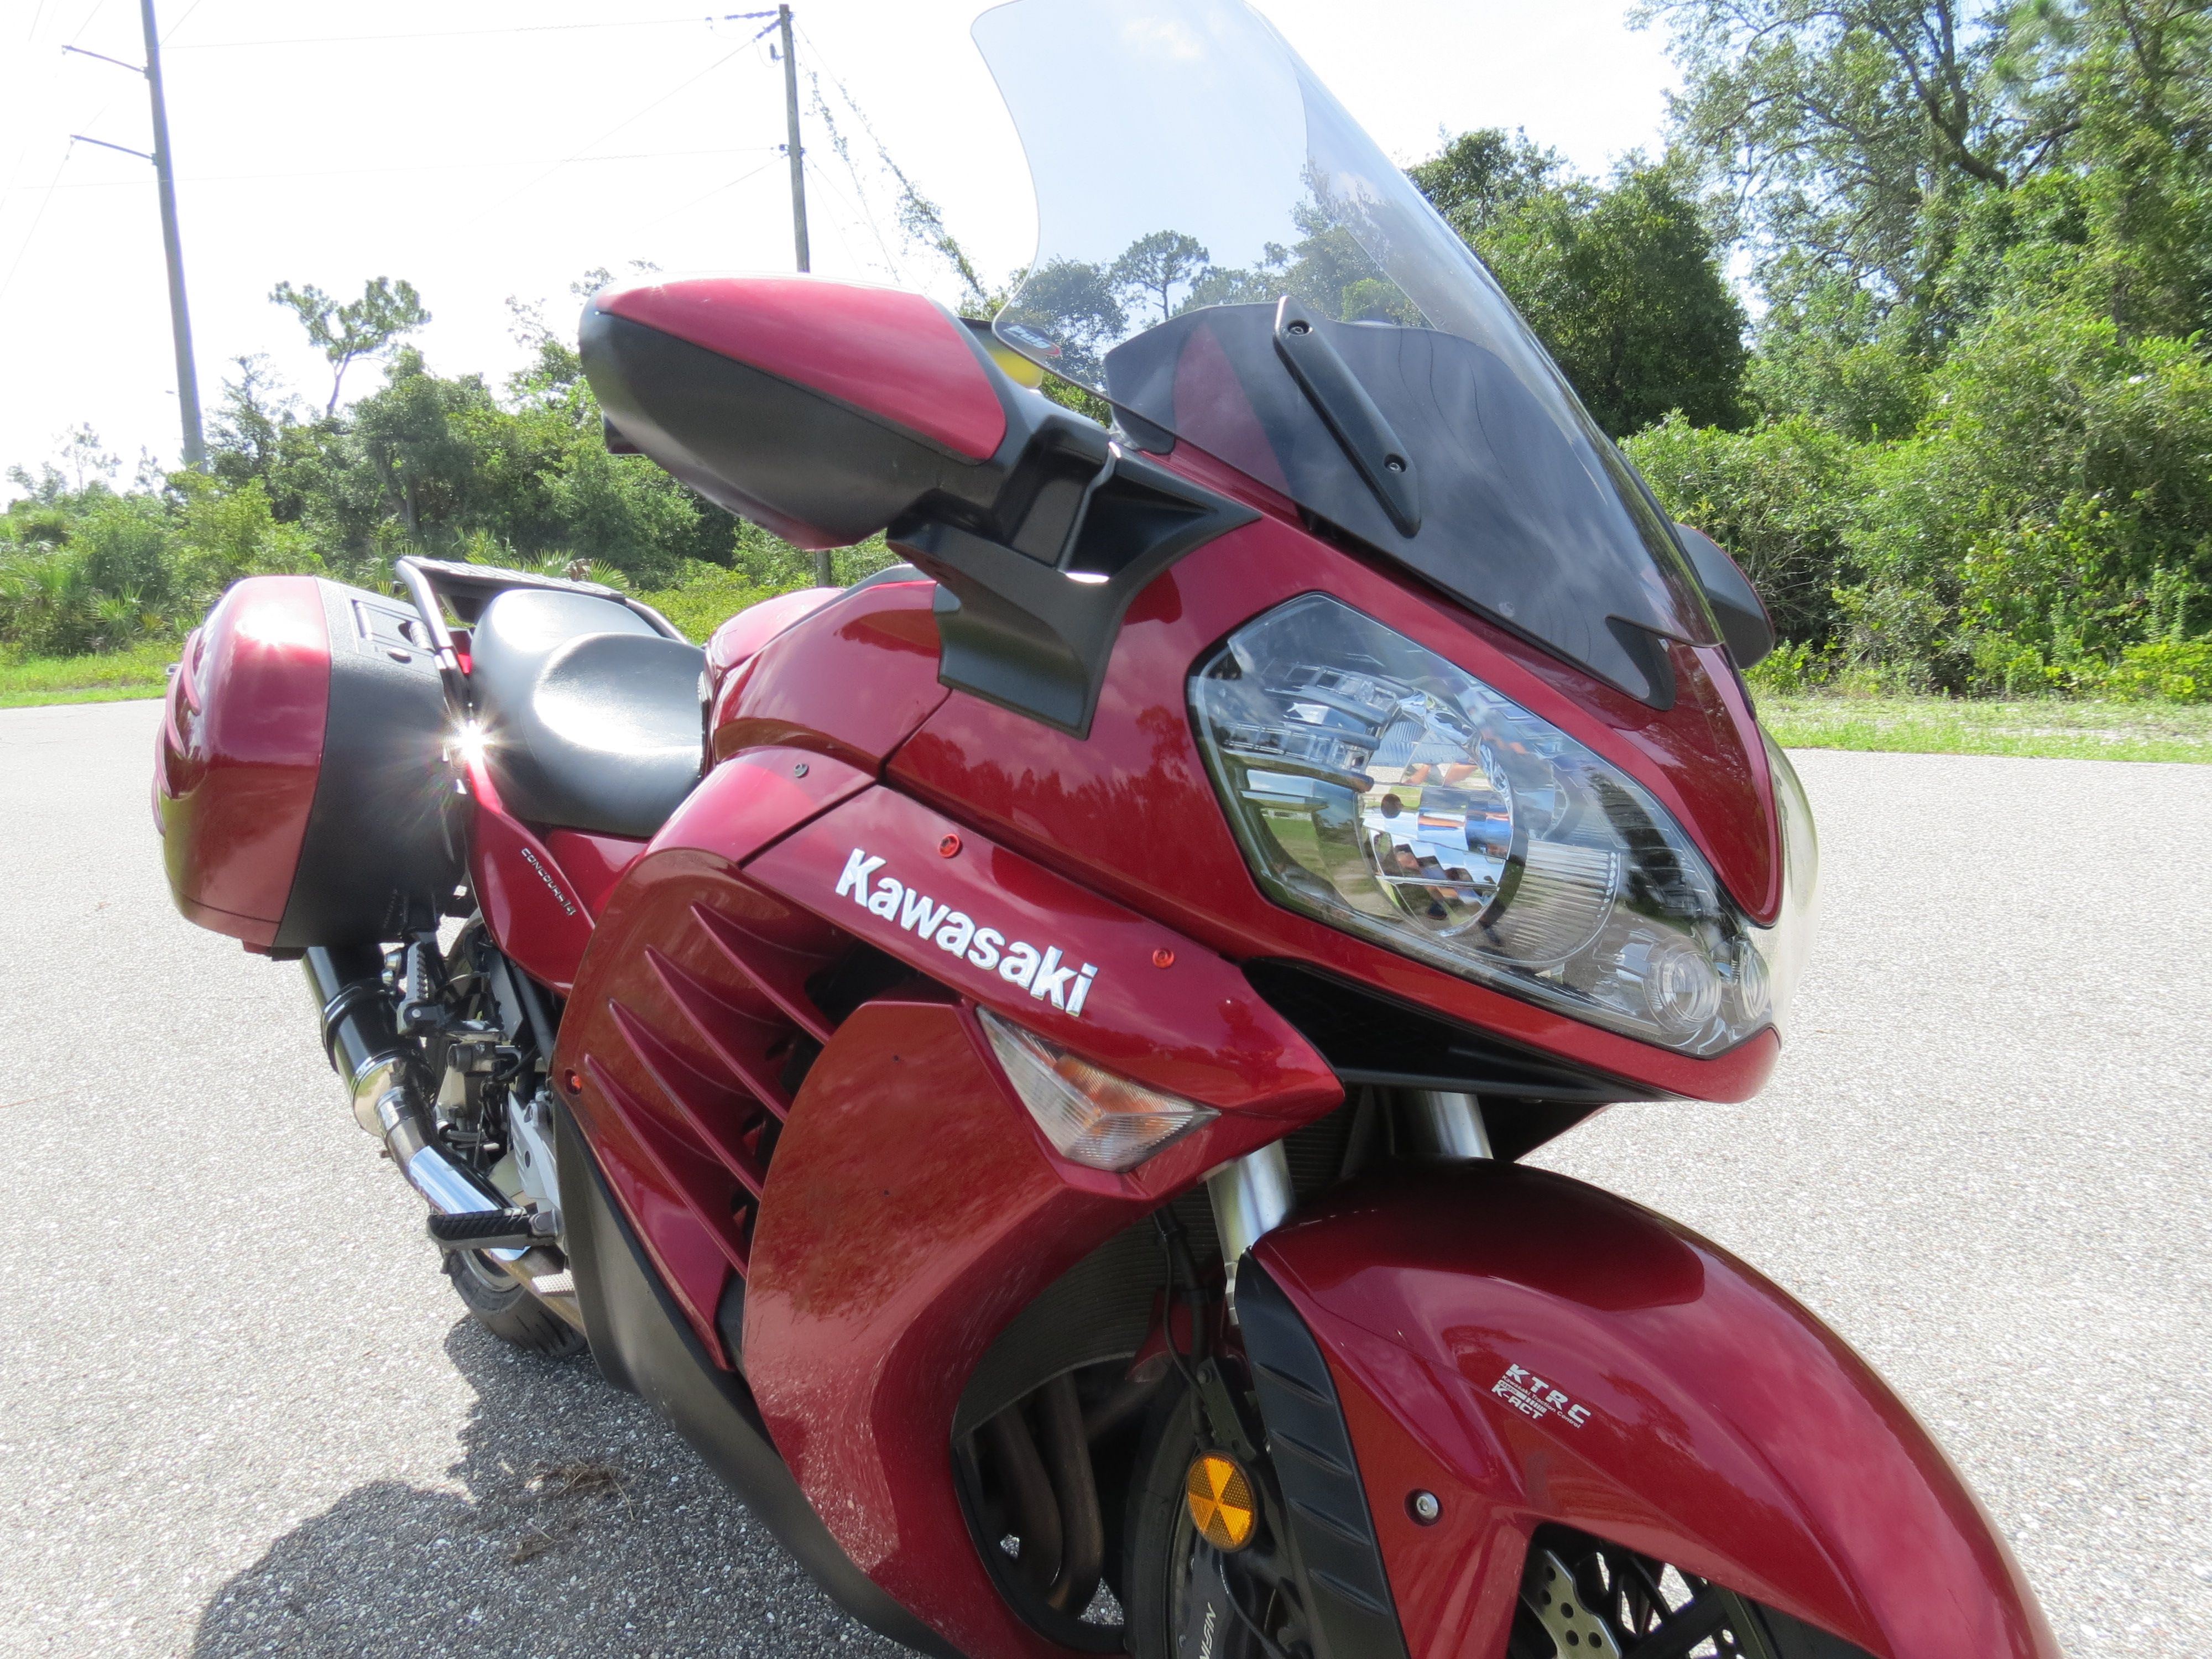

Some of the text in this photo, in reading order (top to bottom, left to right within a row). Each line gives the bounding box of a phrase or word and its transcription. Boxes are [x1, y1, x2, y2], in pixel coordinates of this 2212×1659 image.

[835, 848, 1098, 1017] Kawasaki
[1491, 1384, 1543, 1419] K-ACT
[1502, 1375, 1581, 1428] Kawasaki Traction Control
[1505, 1363, 1592, 1424] KTRC
